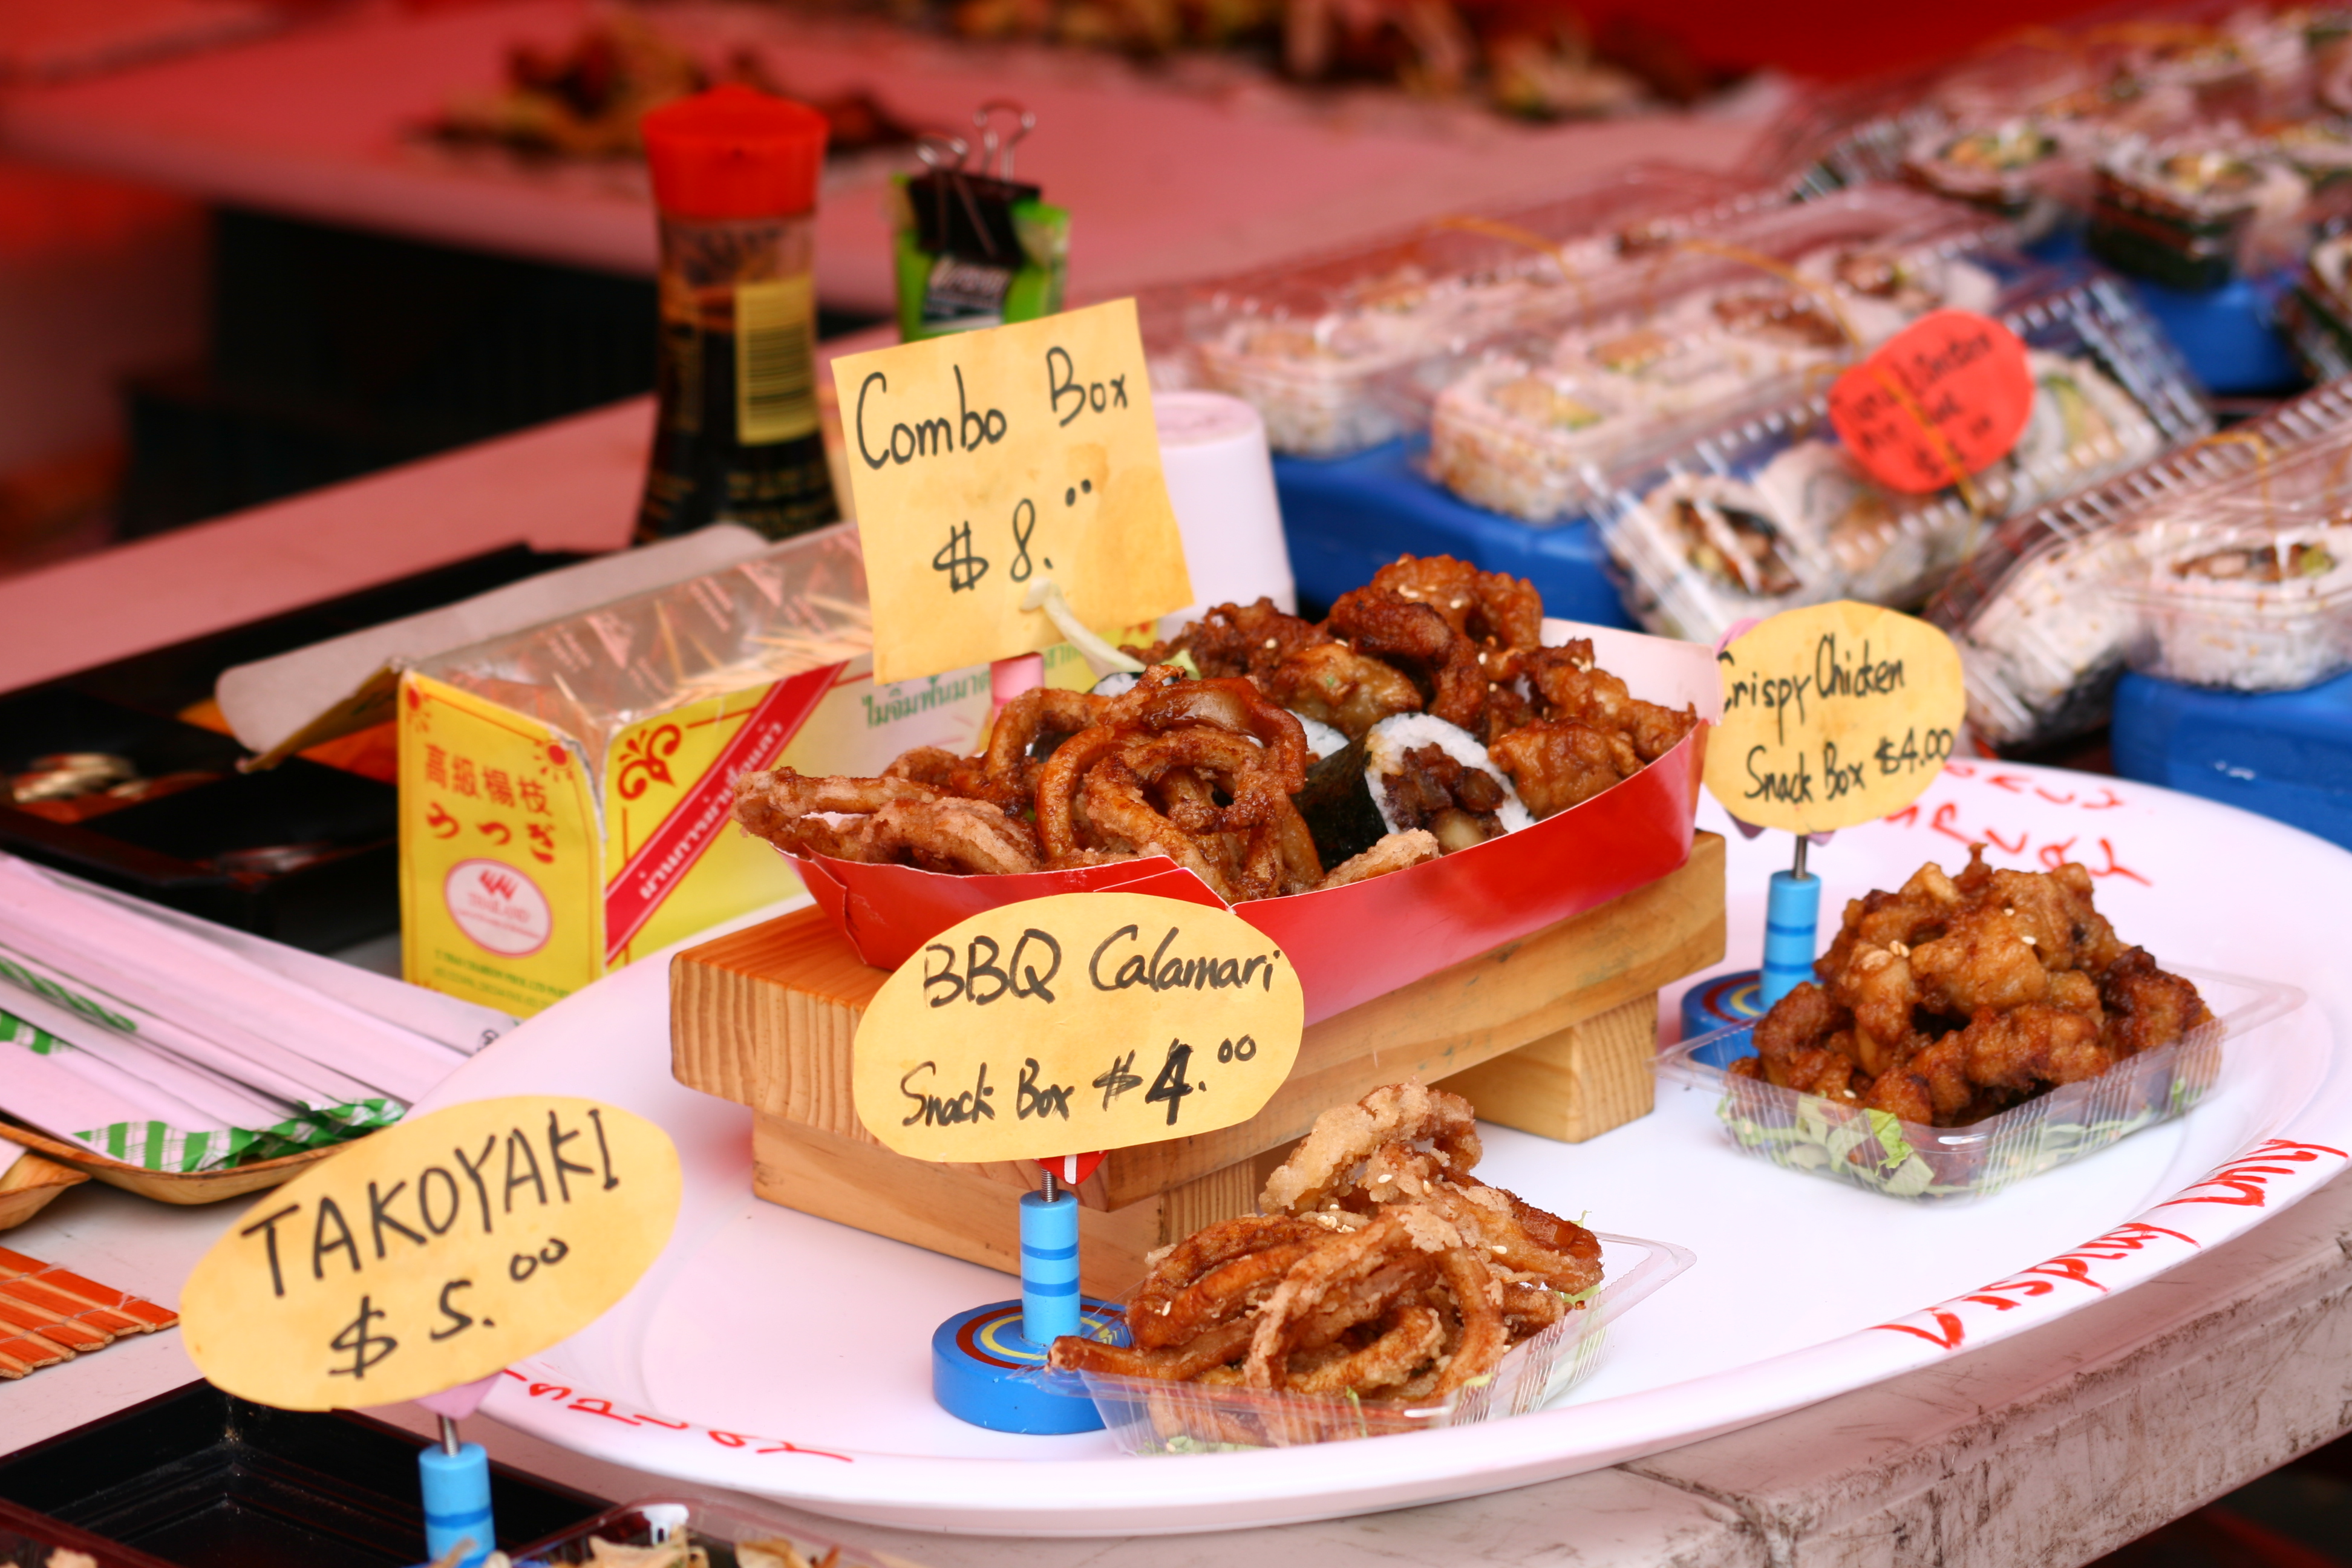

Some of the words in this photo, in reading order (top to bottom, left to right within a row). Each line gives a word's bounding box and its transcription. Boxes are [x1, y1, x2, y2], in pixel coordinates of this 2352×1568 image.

[856, 364, 1007, 470] Combo
[1046, 346, 1128, 427] Box
[1744, 745, 1814, 805] Snack
[1823, 741, 1866, 800] Box
[1874, 727, 1954, 776] $4.00
[923, 929, 1062, 1008] BBQ
[1089, 924, 1281, 991] Calamari
[902, 1061, 995, 1126] Snack
[1016, 1057, 1075, 1120] Box
[241, 1108, 619, 1298] TAKOYAKI
